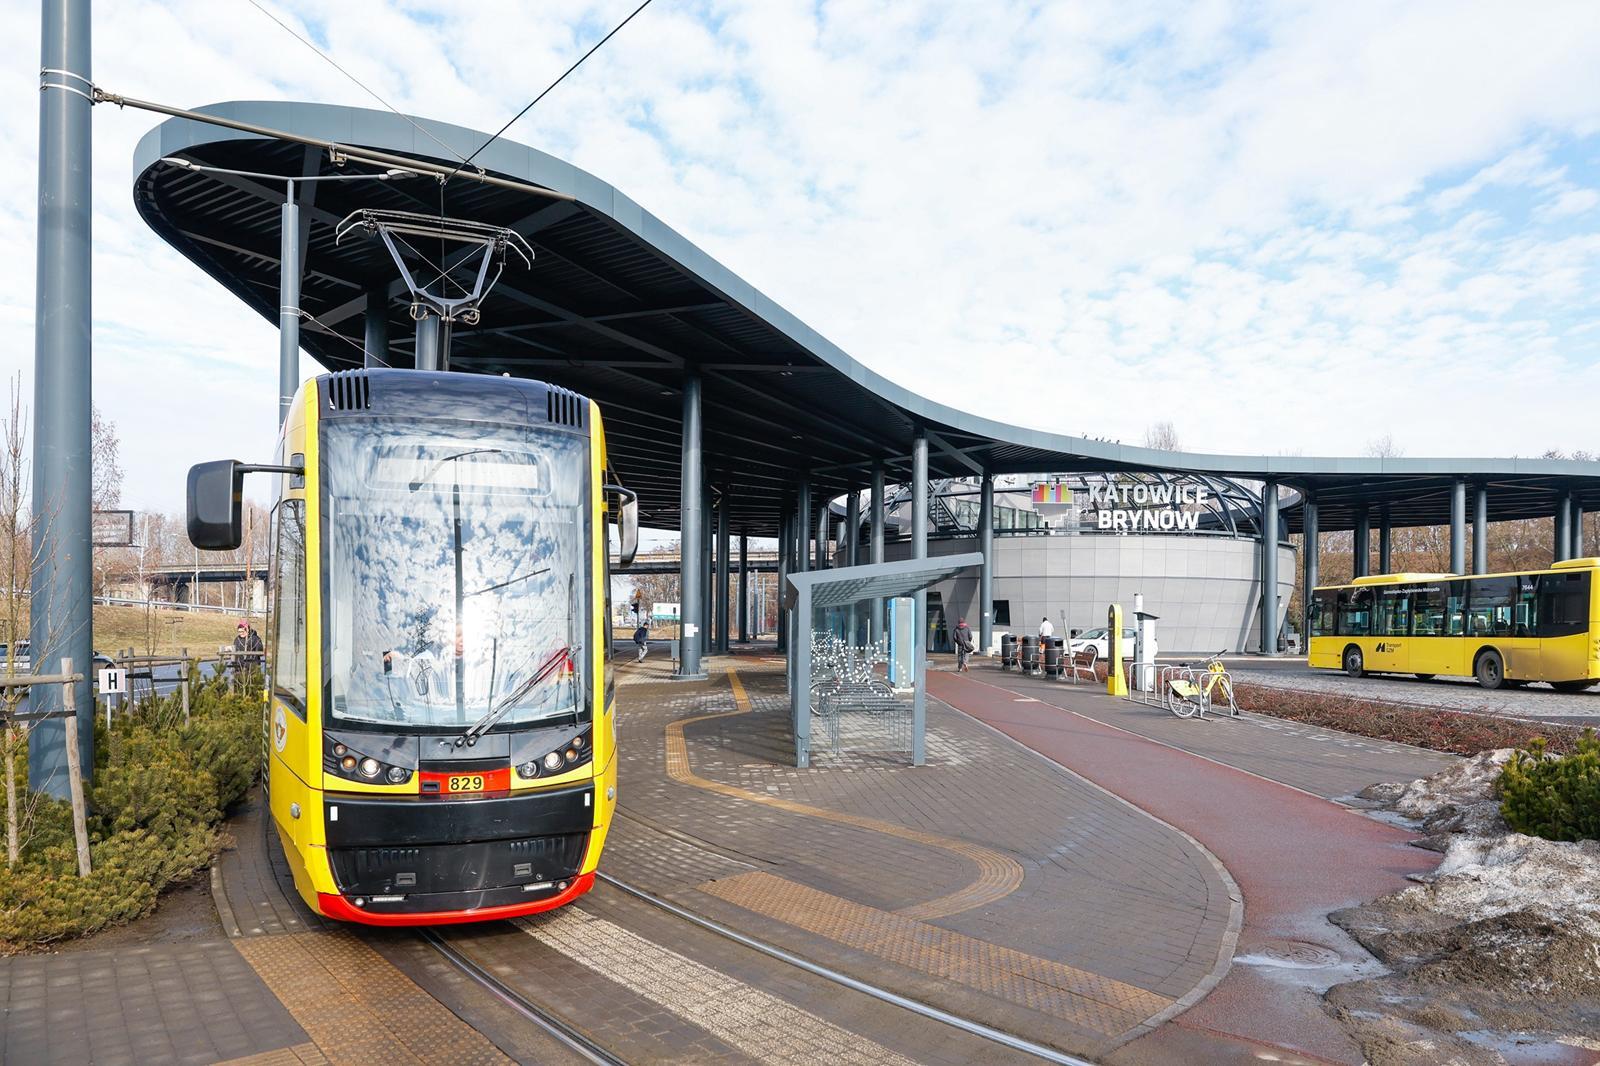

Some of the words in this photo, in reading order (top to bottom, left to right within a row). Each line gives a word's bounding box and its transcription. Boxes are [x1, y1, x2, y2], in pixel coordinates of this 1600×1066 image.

[1089, 484, 1208, 504] KATOWICE
[1098, 505, 1199, 529] BRYNÓW
[108, 672, 117, 689] H
[450, 777, 482, 790] 829
